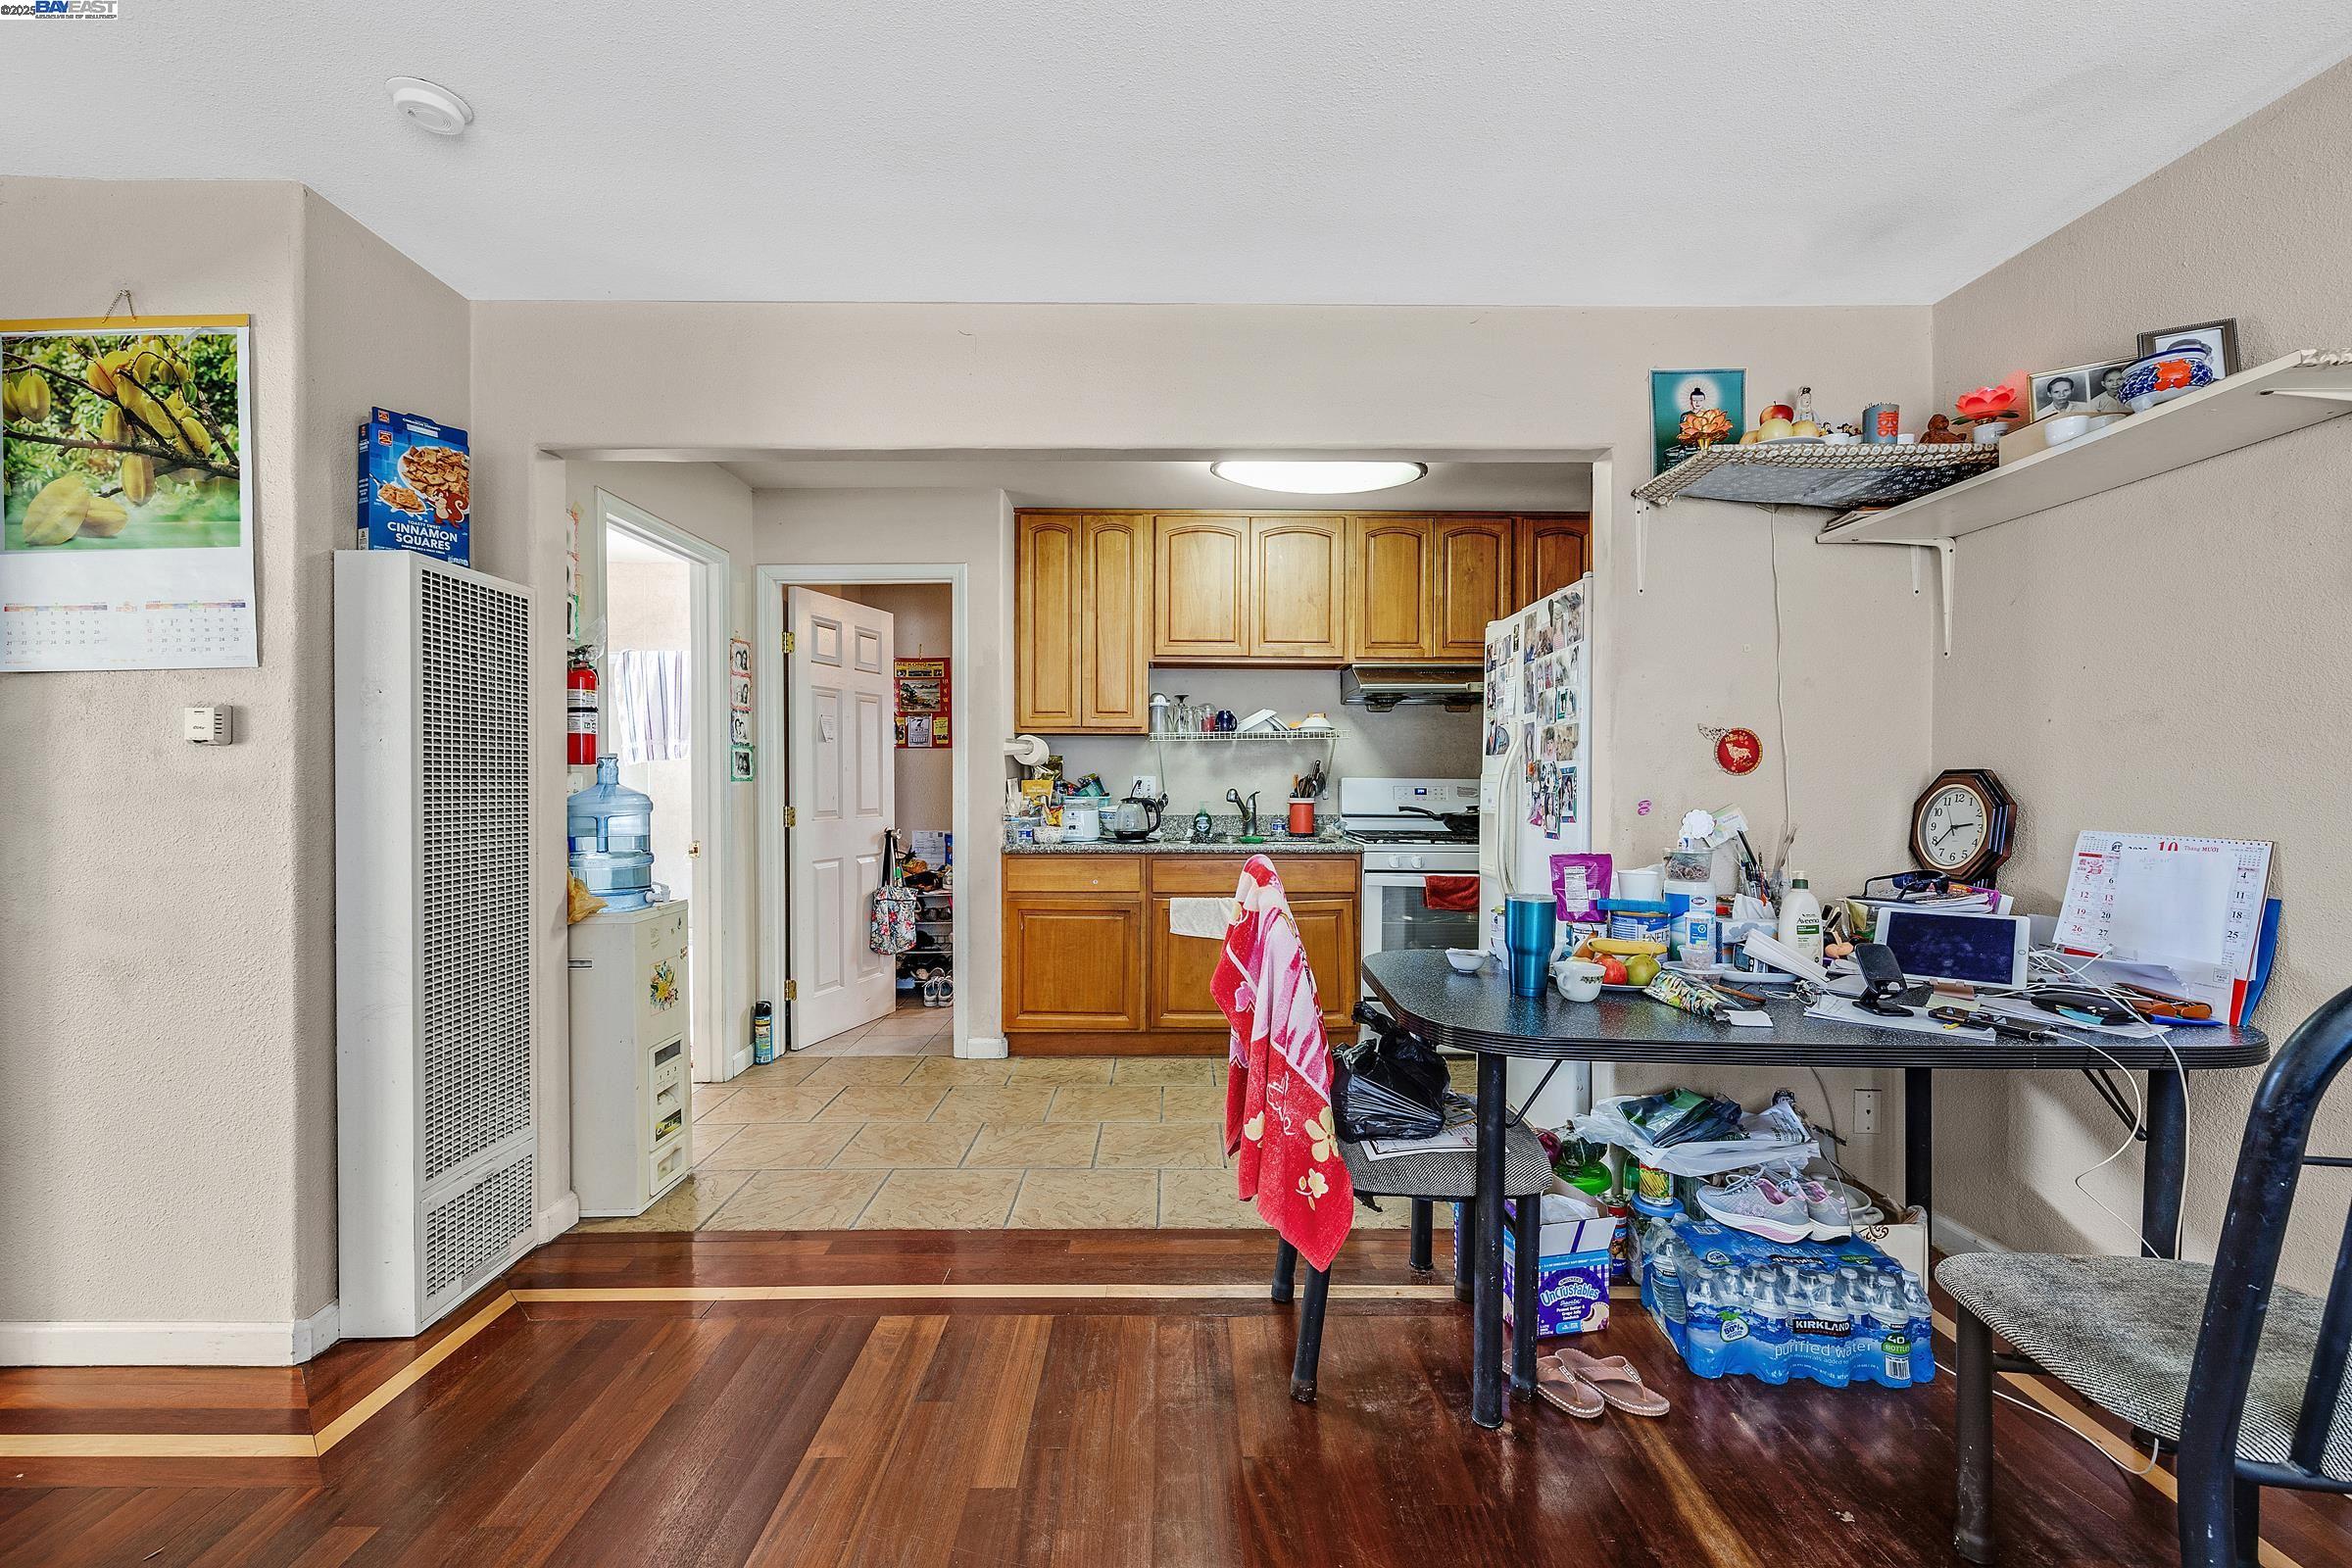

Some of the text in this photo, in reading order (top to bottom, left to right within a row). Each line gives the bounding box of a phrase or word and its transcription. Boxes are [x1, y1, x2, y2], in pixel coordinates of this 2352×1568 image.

[387, 521, 458, 543] CINNAMON
[395, 532, 451, 551] SQUARES
[1943, 797, 1951, 806] 11
[1954, 794, 1965, 803] 12
[1969, 797, 1973, 806] 1
[1934, 808, 1942, 816] 10
[1976, 808, 1983, 817] 2
[1931, 822, 1936, 831] 9
[1977, 823, 1983, 833] 3
[1932, 836, 1937, 845] 8
[1972, 838, 1978, 847] 4
[1938, 848, 1944, 857] 7
[1961, 850, 1968, 858] 5
[2231, 910, 2243, 919] 18
[2227, 930, 2239, 939] 25
[1795, 1320, 1850, 1332] KIRKLAND
[1887, 1335, 1905, 1345] 40
[1775, 1340, 1872, 1359] purified water
